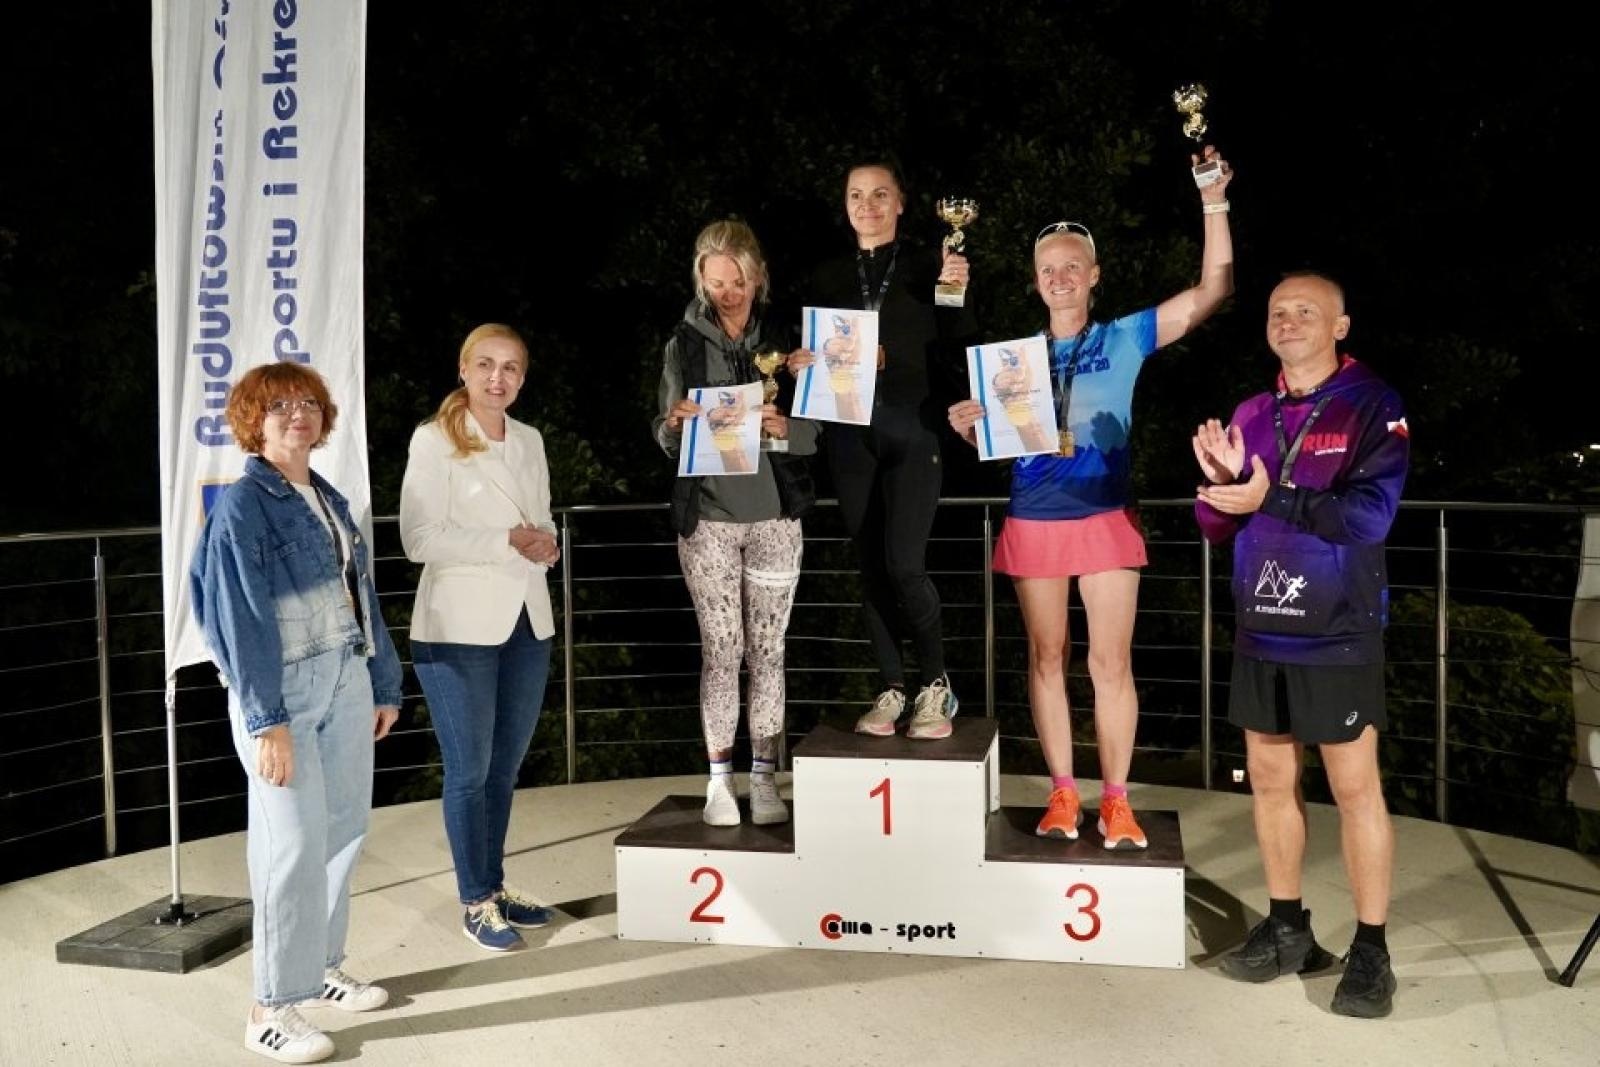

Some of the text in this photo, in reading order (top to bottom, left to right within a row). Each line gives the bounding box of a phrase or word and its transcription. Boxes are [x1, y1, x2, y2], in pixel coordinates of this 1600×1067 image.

[263, 183, 297, 197] i
[191, 108, 234, 448] Rudułtow
[266, 218, 311, 366] portu
[869, 777, 892, 836] 1
[689, 866, 726, 924] 2
[1063, 883, 1101, 941] 3
[896, 922, 956, 942] sport
